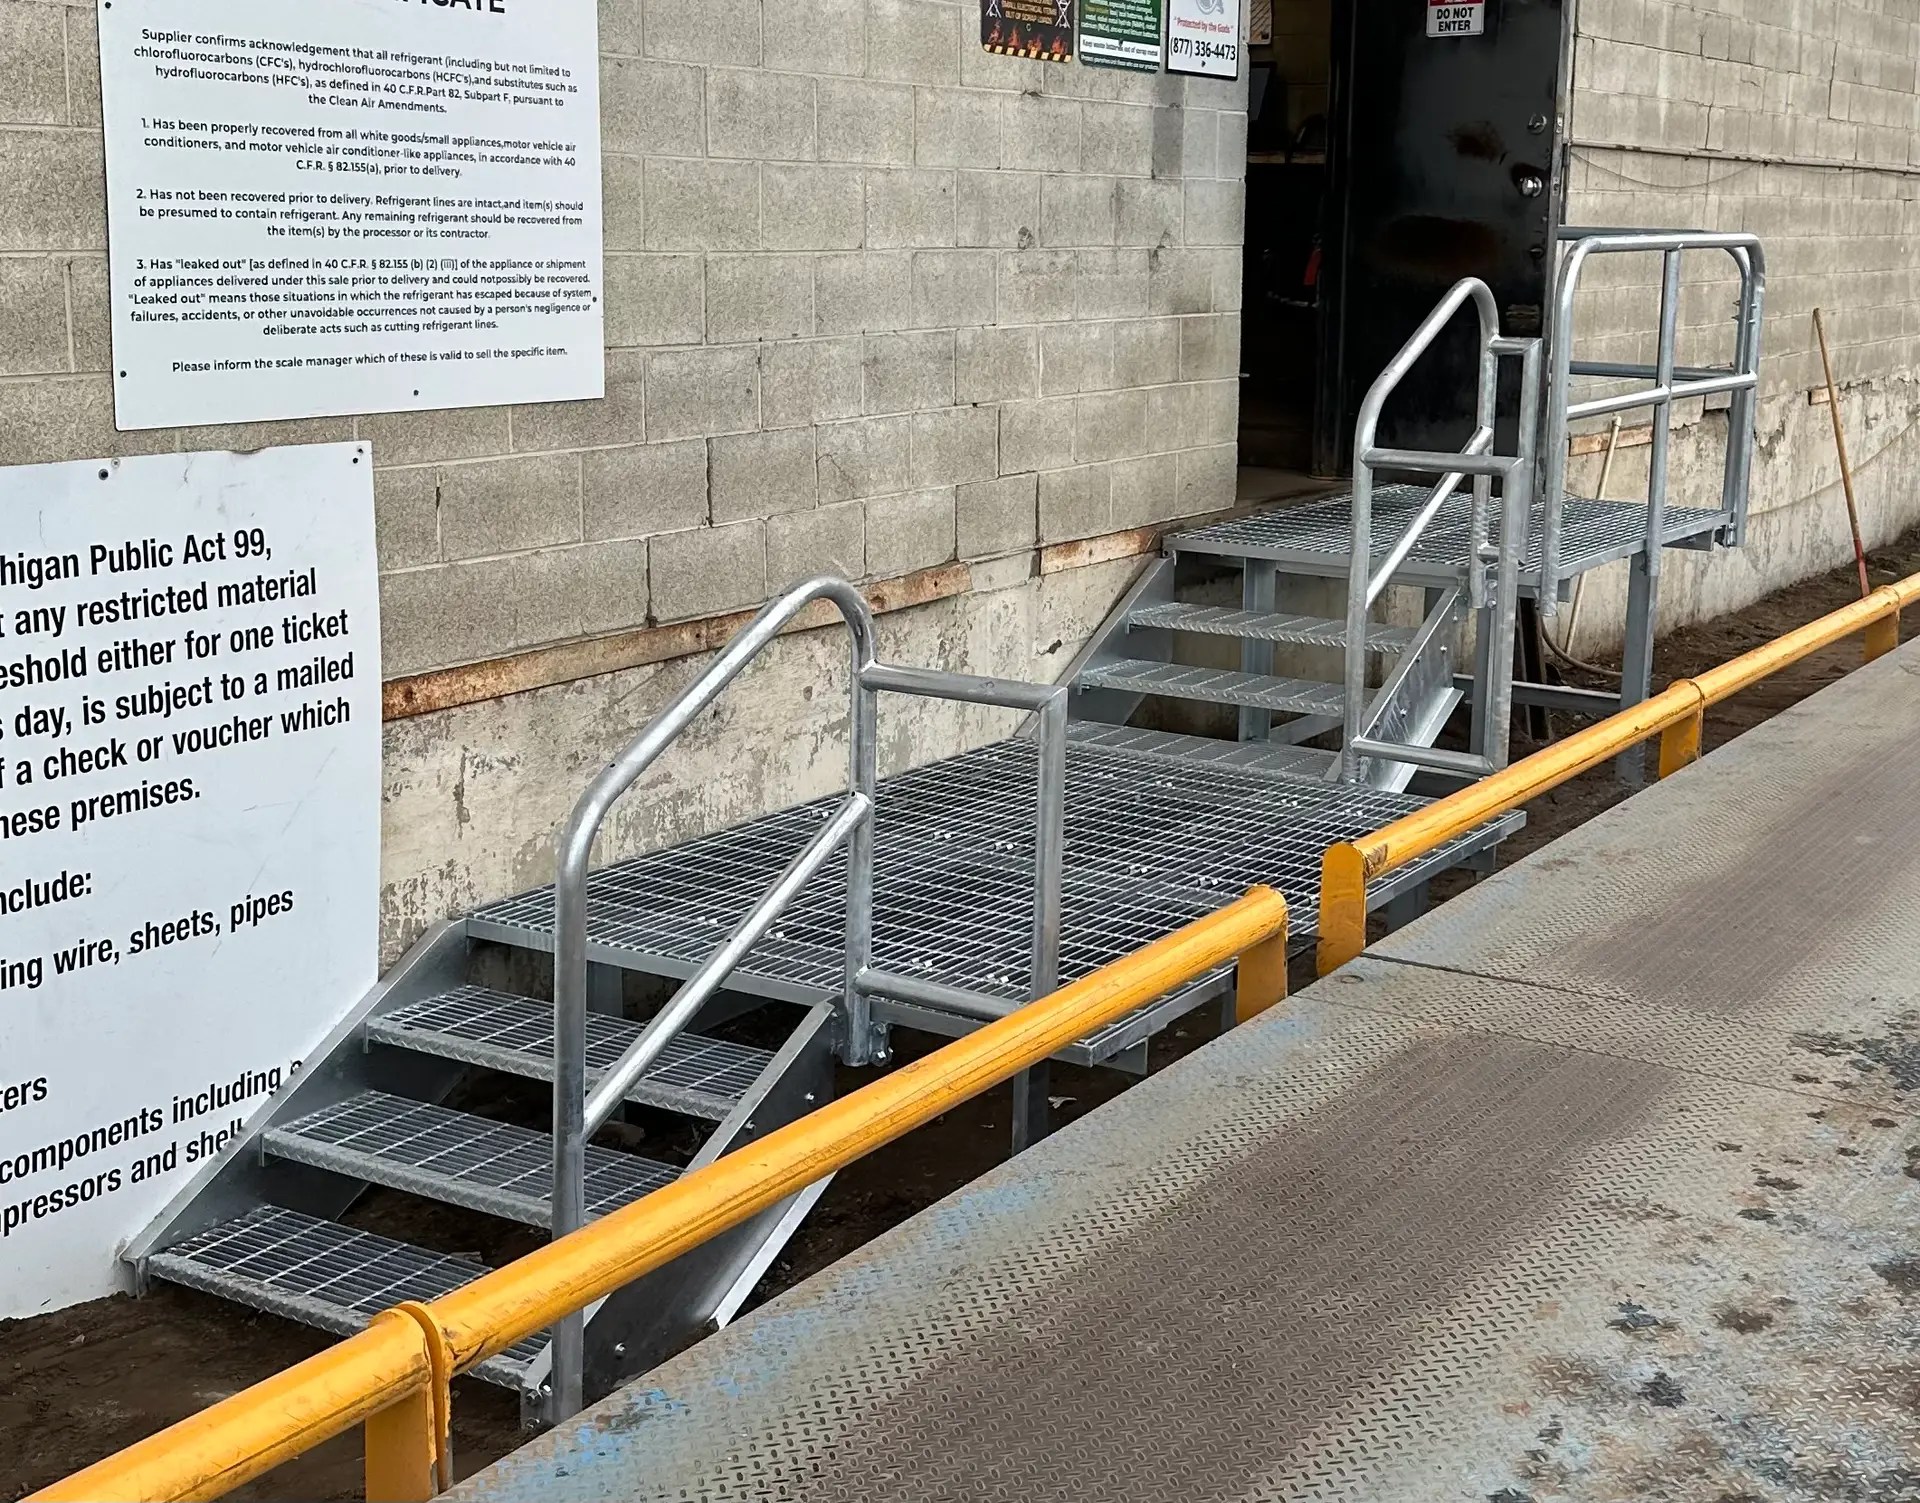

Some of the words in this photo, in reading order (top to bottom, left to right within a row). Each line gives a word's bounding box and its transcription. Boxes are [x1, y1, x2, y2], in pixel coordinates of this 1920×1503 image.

[1436, 8, 1450, 19] DO
[1453, 7, 1474, 19] NOT
[1438, 20, 1471, 32] ENTER
[133, 45, 253, 66] chlorofluorocarbons
[298, 58, 430, 80] hydrochlorofluorocarbons
[493, 76, 543, 90] substitutes
[545, 81, 566, 92] such
[567, 84, 577, 93] as
[141, 28, 192, 44] Supplier
[194, 33, 246, 48] confirms
[248, 38, 351, 57] acknowledgement
[351, 47, 374, 59] that
[375, 49, 388, 60] all
[390, 51, 443, 66] refrigerant
[444, 55, 492, 72] (including
[493, 60, 510, 72] but
[511, 64, 527, 74] not
[528, 63, 560, 77] limited
[561, 68, 571, 77] to
[1170, 37, 1193, 58] (877)
[1194, 40, 1236, 61] 336-4473
[307, 92, 326, 105] the
[328, 94, 358, 107] Clean
[360, 96, 375, 108] Air
[377, 98, 447, 113] Amendments.
[140, 117, 150, 128] 1.
[152, 117, 175, 132] Has
[177, 118, 208, 132] been
[210, 122, 258, 136] properly
[261, 125, 315, 137] recovered
[317, 126, 343, 139] from
[345, 128, 357, 140] all
[359, 129, 389, 141] white
[390, 131, 449, 144] goods/small
[532, 139, 563, 151] vehicle
[564, 141, 576, 152] air
[139, 204, 155, 217] be
[157, 206, 217, 220] presumed
[219, 207, 232, 218] to
[234, 207, 277, 219] contain
[279, 208, 340, 222] refrigerant.
[341, 210, 362, 223] Any
[364, 210, 415, 224] remaining
[417, 211, 469, 224] refrigerant
[470, 213, 501, 223] should
[503, 213, 515, 224] be
[517, 215, 560, 225] recovered
[561, 214, 582, 225] from
[266, 224, 285, 236] the
[287, 224, 325, 238] item(s)
[327, 225, 340, 239] by
[342, 225, 360, 237] the
[362, 228, 411, 239] processor
[413, 229, 424, 237] or
[425, 226, 438, 238] its
[439, 228, 490, 238] contractor.
[133, 275, 147, 287] of
[149, 274, 214, 289] appliances
[216, 274, 268, 286] delivered
[271, 274, 304, 285] under
[305, 273, 326, 285] this
[327, 274, 349, 285] sale
[351, 273, 376, 287] prior
[377, 275, 388, 285] to
[390, 273, 430, 286] delivery
[431, 273, 450, 284] and
[451, 273, 478, 284] could
[533, 273, 545, 283] be
[546, 273, 590, 283] recovered.
[262, 323, 317, 335] deliberate
[319, 323, 341, 334] acts
[343, 321, 368, 333] such
[370, 323, 382, 332] as
[383, 320, 419, 333] cutting
[422, 319, 472, 332] refrigerant
[474, 318, 499, 329] lines.
[172, 360, 210, 372] Please
[213, 359, 251, 371] inform
[254, 357, 273, 369] the
[275, 355, 303, 368] scale
[305, 356, 353, 367] manager
[354, 352, 385, 364] which
[387, 352, 398, 363] of
[399, 351, 427, 362] these
[429, 350, 437, 361] is
[438, 349, 462, 360] valid
[463, 350, 474, 360] to
[475, 348, 491, 359] sell
[492, 347, 509, 358] the
[510, 345, 544, 359] specific
[545, 345, 567, 356] item.
[0, 552, 78, 589] higan
[90, 538, 172, 574] Public
[183, 533, 226, 564] Act
[234, 528, 270, 560] 99,
[15, 606, 65, 637] any
[77, 581, 207, 626] restricted
[218, 567, 315, 607] material
[98, 639, 175, 672] either
[184, 630, 220, 659] for
[230, 626, 273, 652] one
[282, 609, 348, 643] ticket
[15, 705, 71, 738] day,
[83, 695, 105, 725] is
[116, 676, 212, 719] subject
[220, 674, 244, 700] to
[254, 673, 267, 695] a
[277, 651, 353, 690] mailed
[16, 761, 31, 785] a
[44, 738, 127, 779] check
[137, 736, 163, 761] or
[172, 715, 272, 754] voucher
[281, 697, 349, 733] which
[71, 778, 199, 831] premises.
[0, 957, 41, 989] ing
[53, 938, 119, 974] wire,
[127, 910, 219, 954] sheets,
[231, 890, 292, 932] pipes
[0, 1108, 162, 1183] components
[173, 1067, 282, 1123] including
[0, 1169, 120, 1236] pressors
[131, 1141, 176, 1183] and
